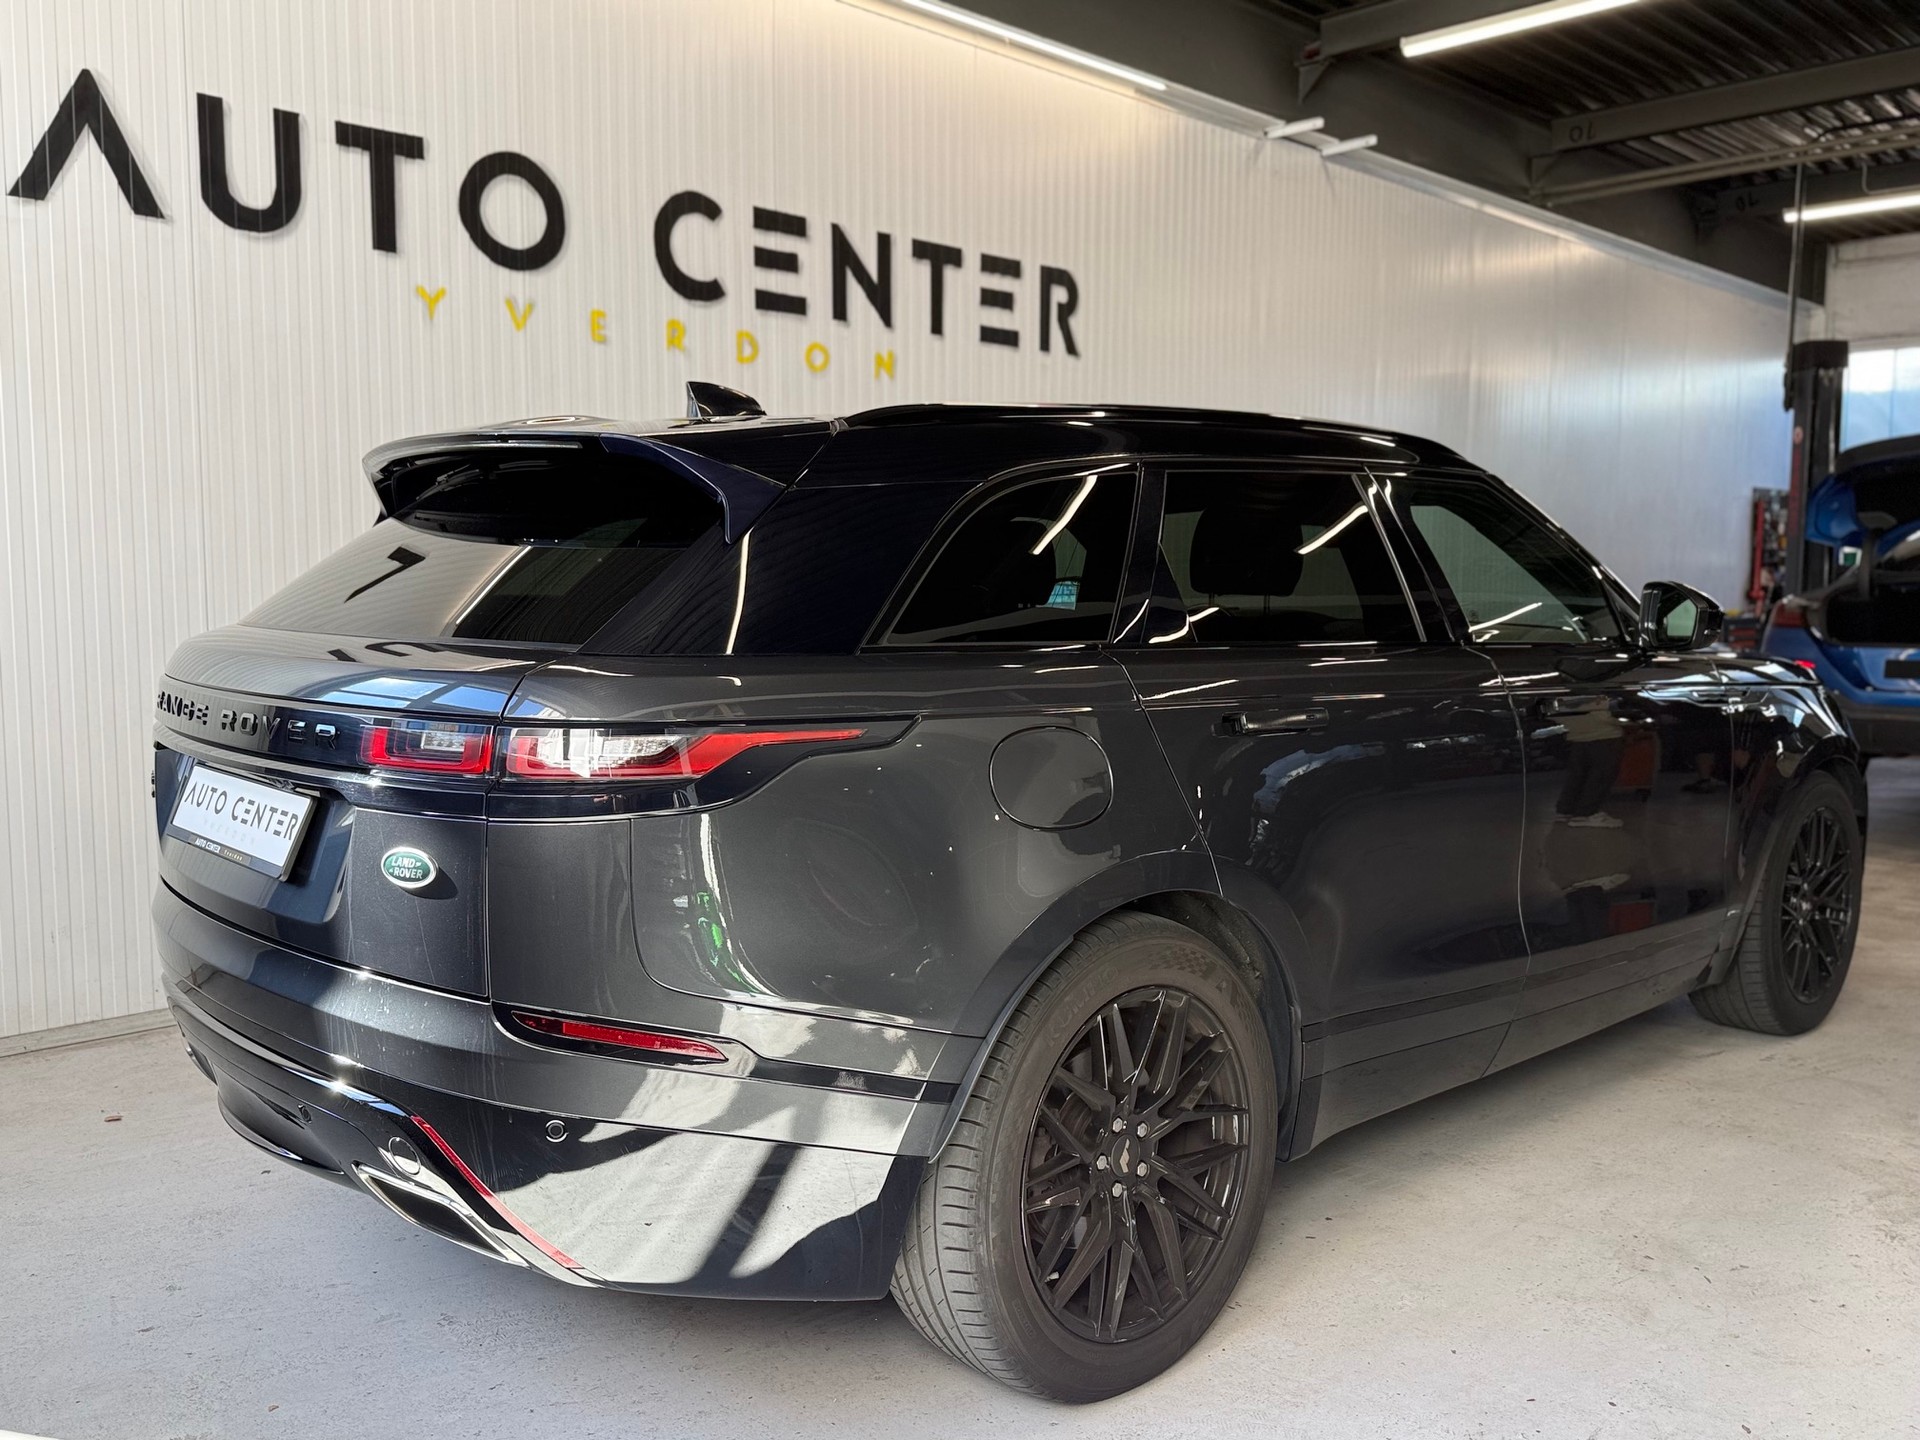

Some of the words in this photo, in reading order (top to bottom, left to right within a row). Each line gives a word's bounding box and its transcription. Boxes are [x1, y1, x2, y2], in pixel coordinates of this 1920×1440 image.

[7, 68, 566, 271] AUTO
[653, 190, 1082, 358] CENTER
[416, 285, 898, 380] YVERDON
[221, 709, 337, 750] ROVER
[185, 782, 227, 815] AUTO
[231, 796, 299, 840] CENTER
[391, 856, 416, 868] LAND
[393, 866, 423, 879] ROVER
